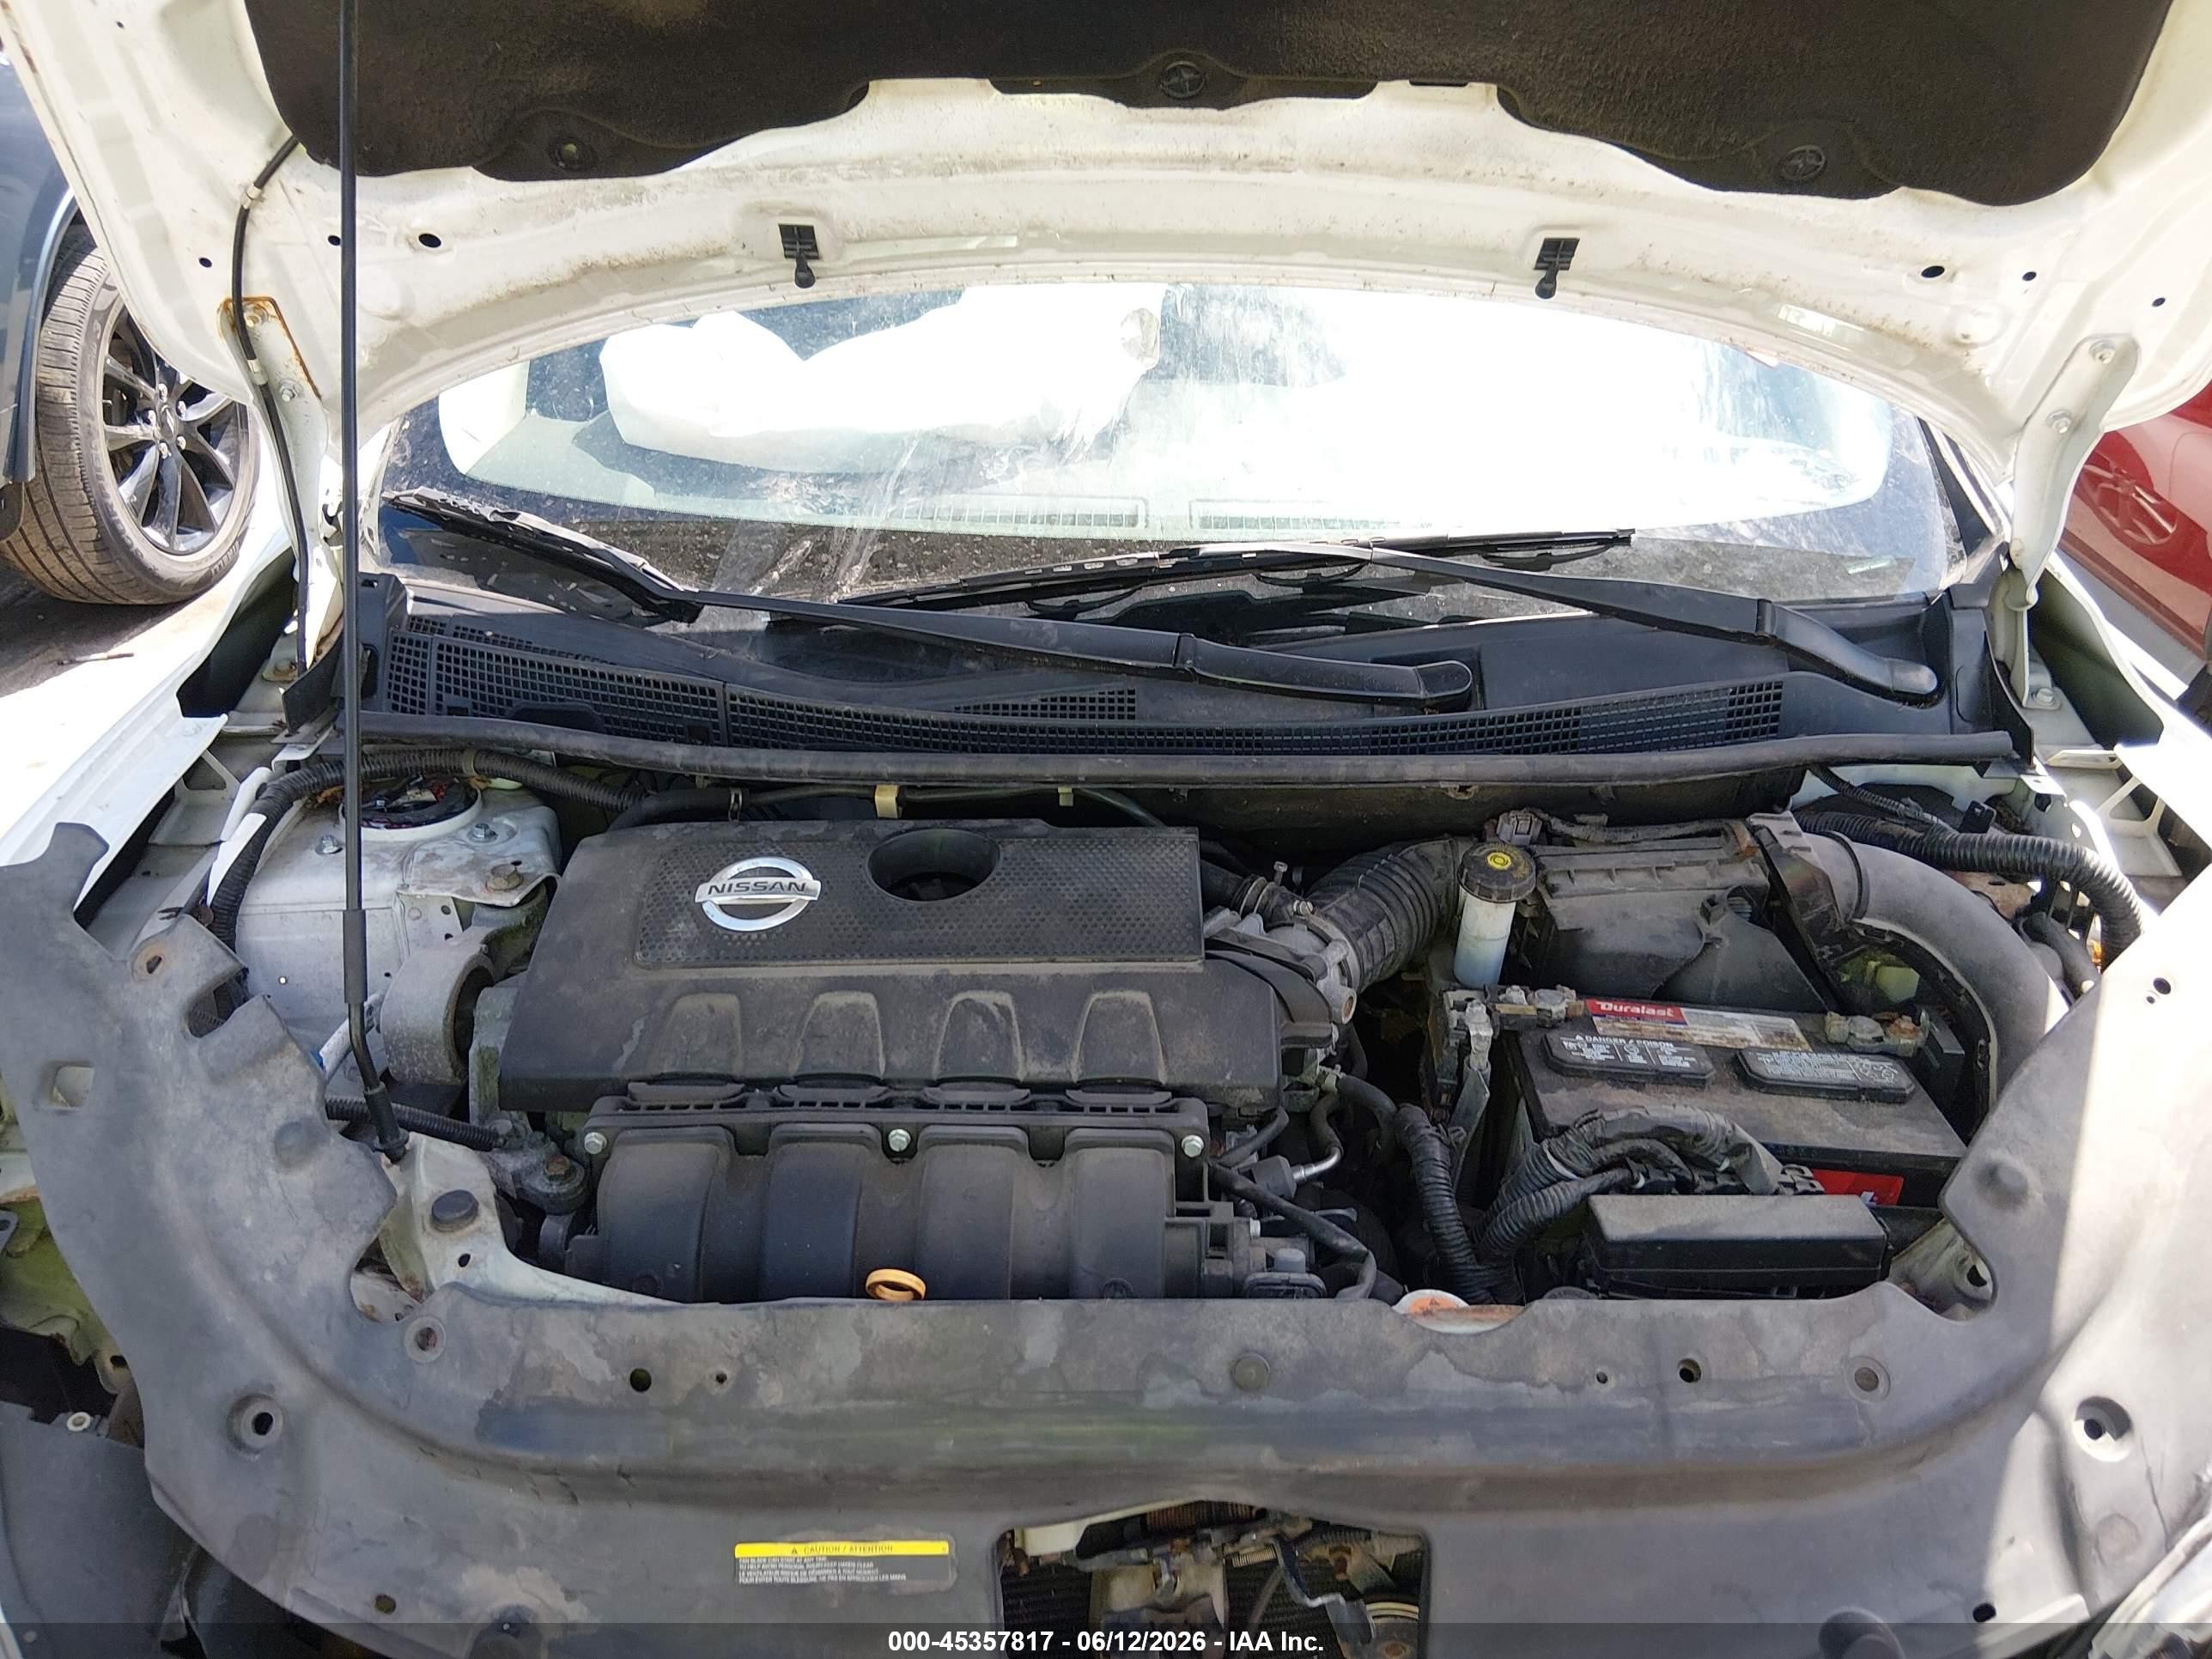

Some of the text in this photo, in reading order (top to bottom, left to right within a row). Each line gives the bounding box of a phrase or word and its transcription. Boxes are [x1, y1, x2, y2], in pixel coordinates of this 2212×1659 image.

[708, 881, 807, 896] NISSAN
[1595, 1000, 1674, 1017] Duralast
[1585, 1035, 1626, 1045] DANGER
[804, 1545, 840, 1554] CAUTION
[848, 1545, 892, 1553] ATTENTION
